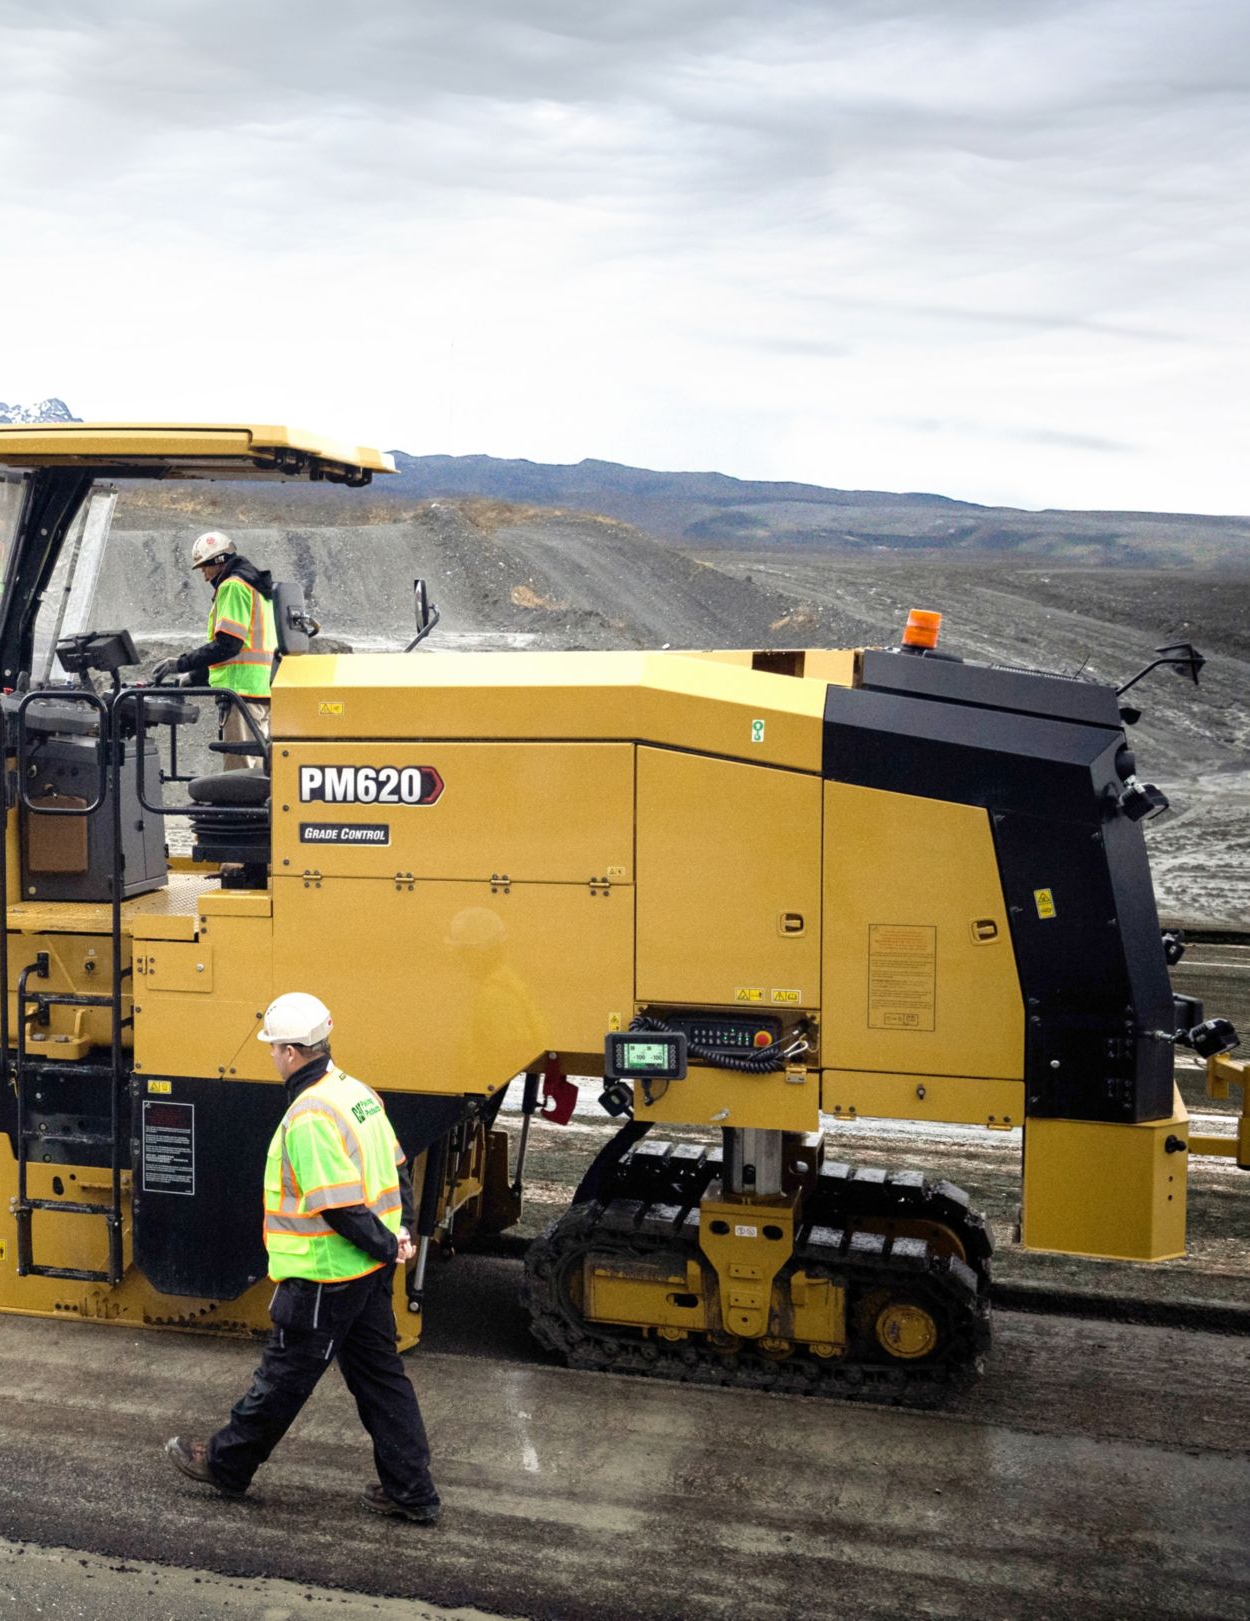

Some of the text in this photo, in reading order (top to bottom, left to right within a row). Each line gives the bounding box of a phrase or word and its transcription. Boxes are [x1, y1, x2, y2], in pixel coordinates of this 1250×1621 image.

[301, 767, 421, 802] PM620
[304, 827, 386, 841] GRADE CONTROL
